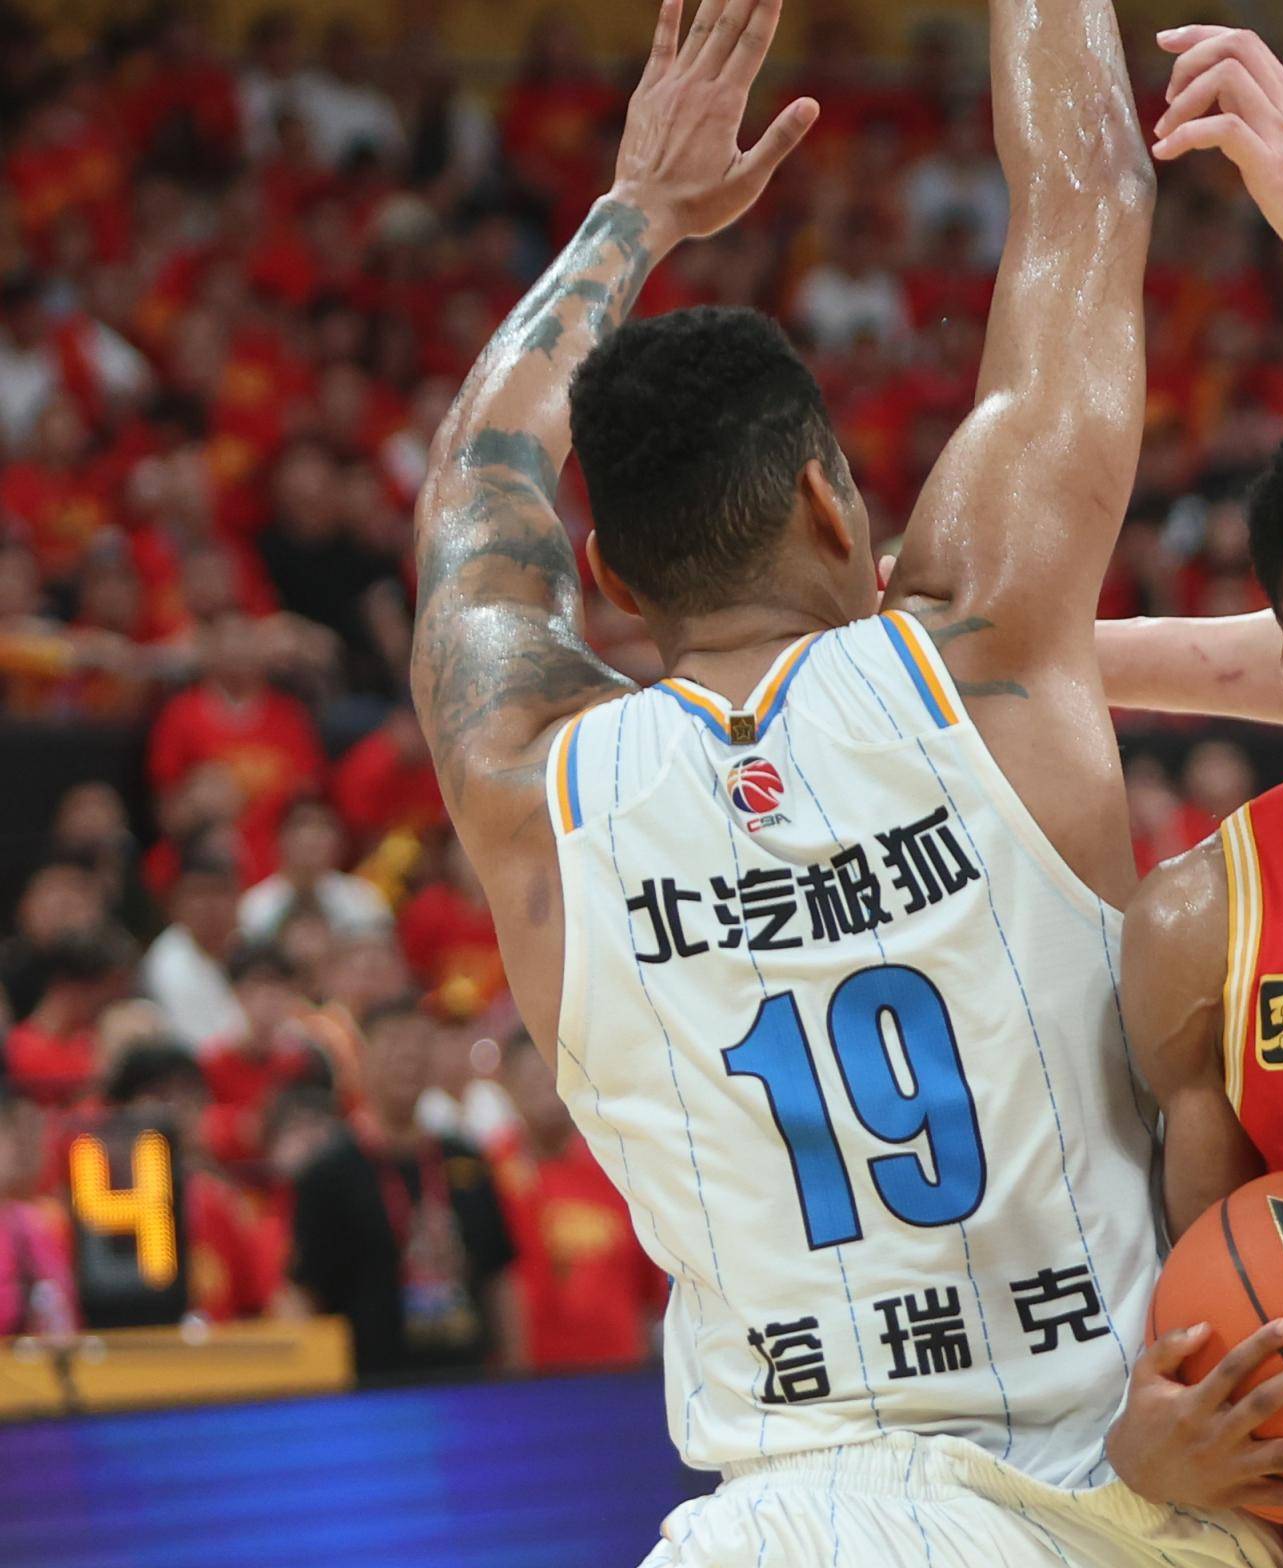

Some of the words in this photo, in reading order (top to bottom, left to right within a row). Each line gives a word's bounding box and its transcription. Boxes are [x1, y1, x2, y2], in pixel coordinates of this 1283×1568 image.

[625, 805, 982, 964] 北汽极狐
[747, 813, 792, 833] CBA
[720, 963, 988, 1253] 19
[68, 1129, 178, 1291] 4
[747, 1263, 1112, 1404] 塔瑞克
